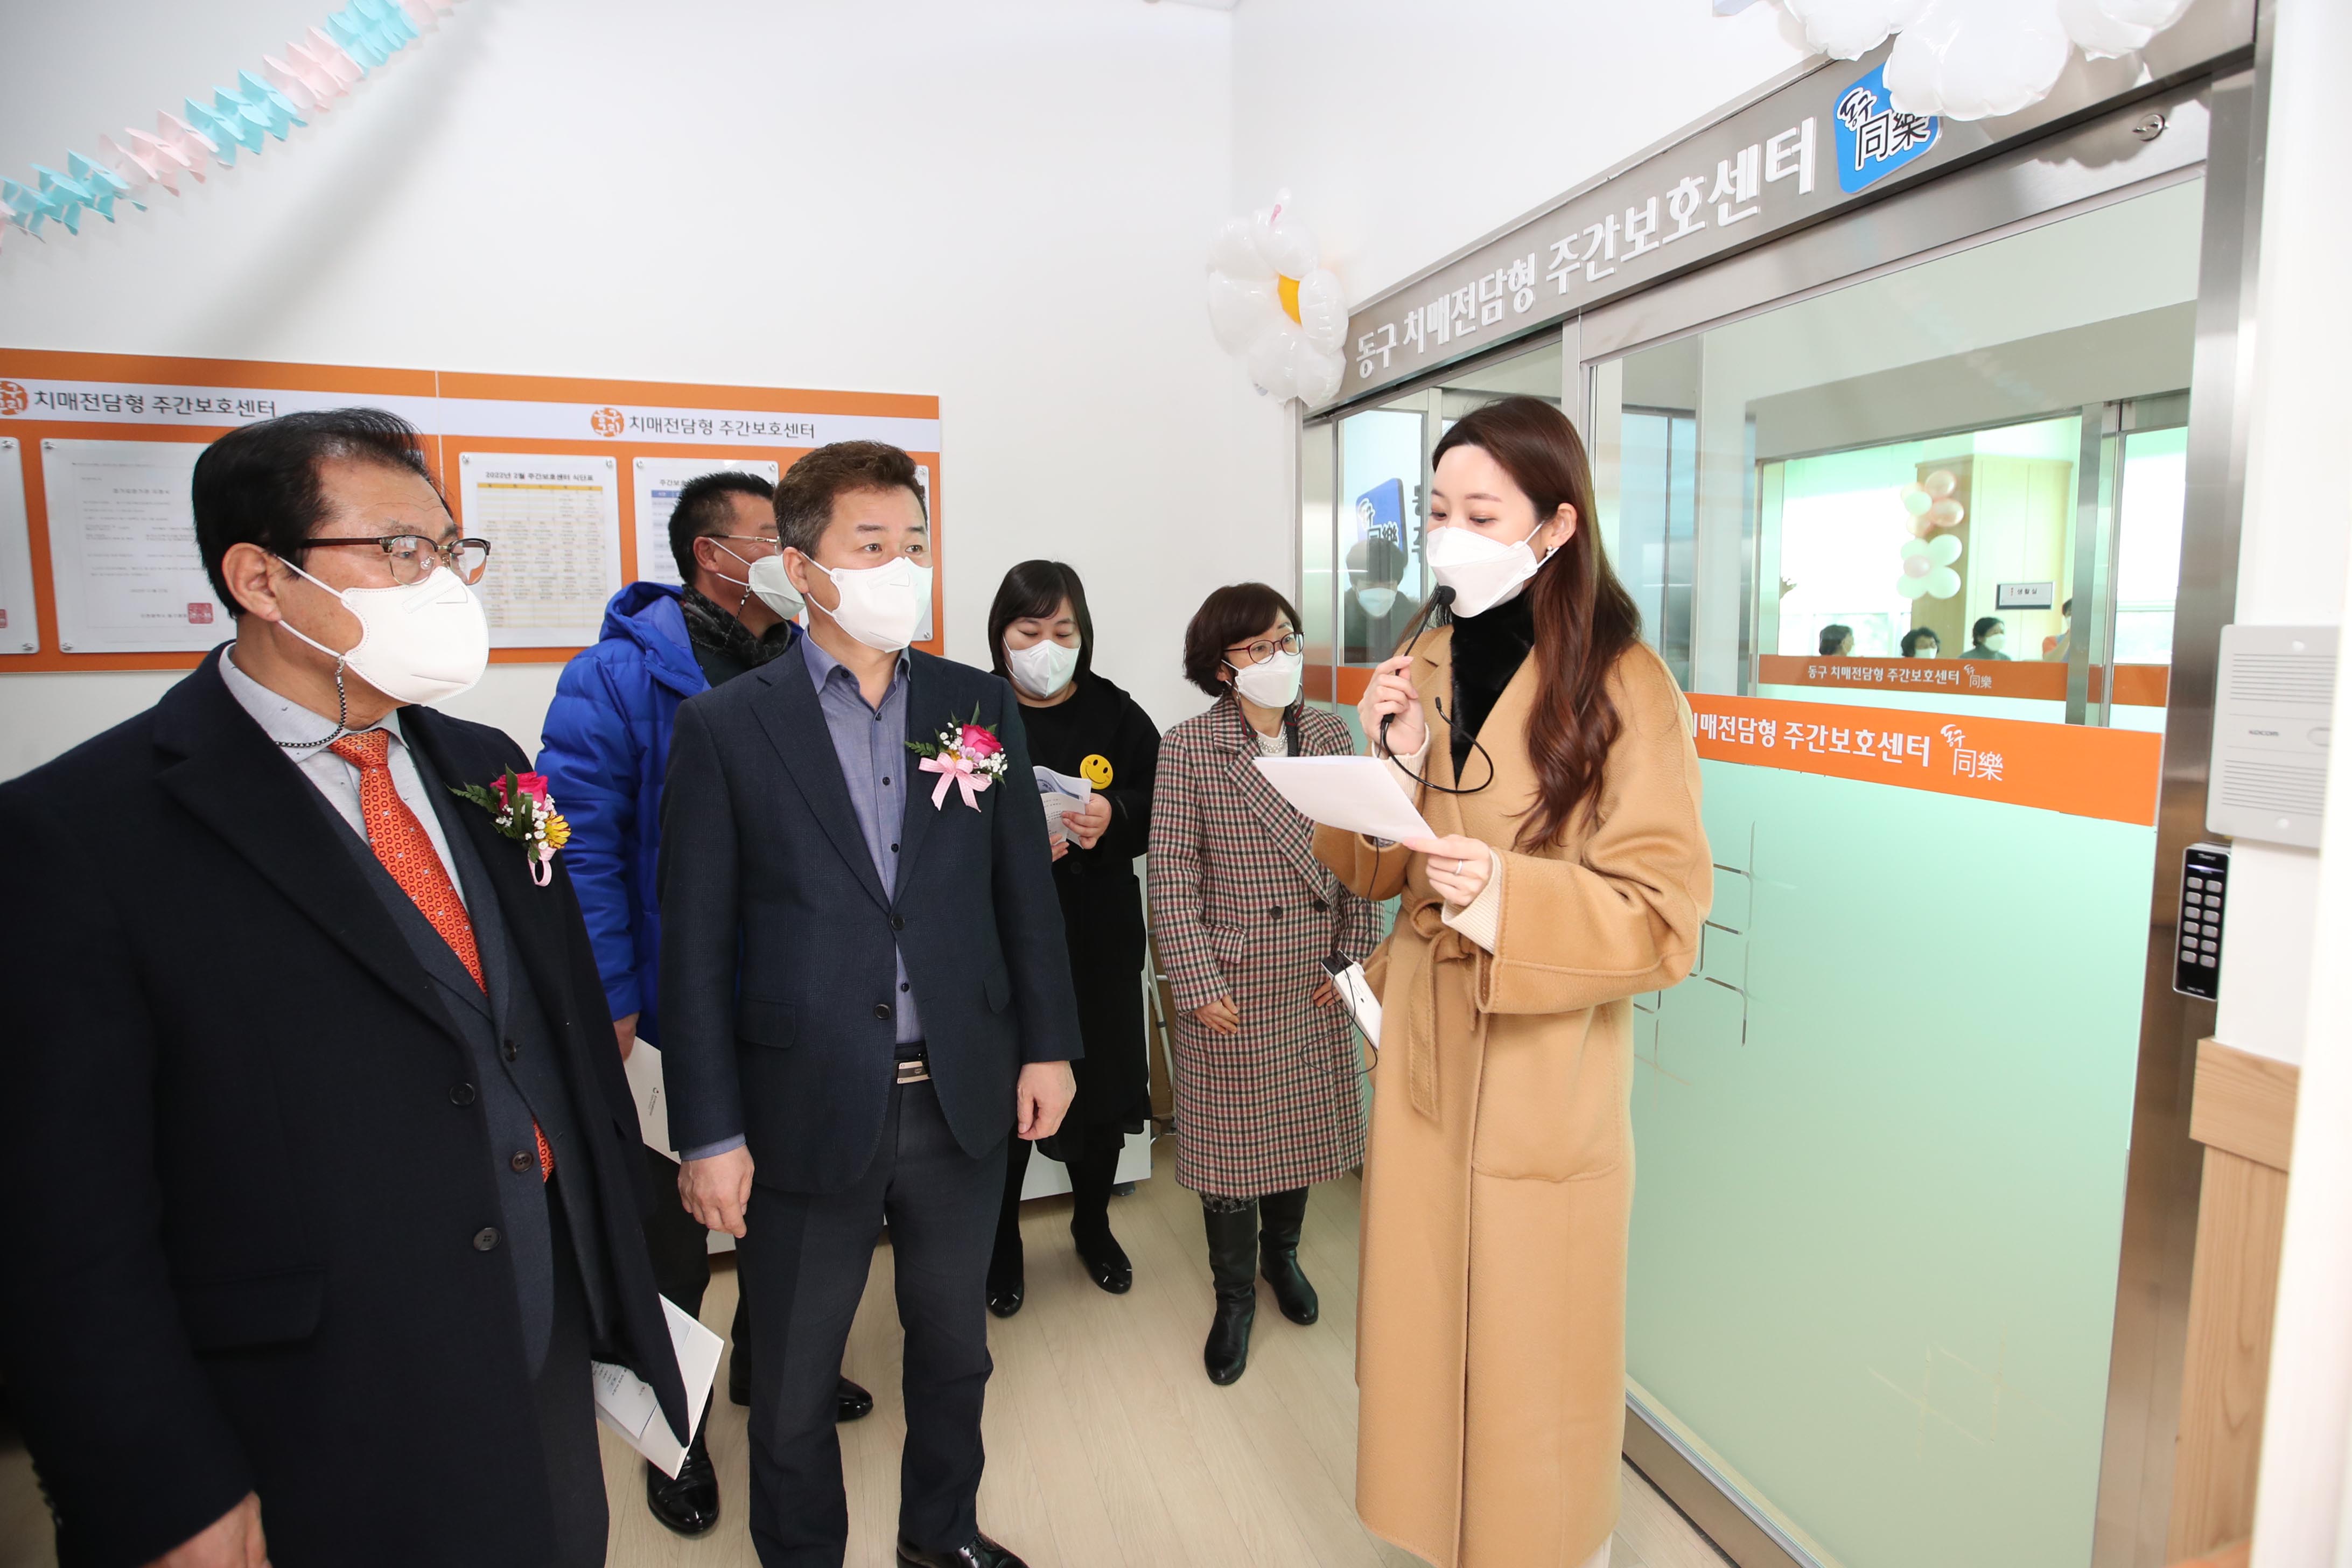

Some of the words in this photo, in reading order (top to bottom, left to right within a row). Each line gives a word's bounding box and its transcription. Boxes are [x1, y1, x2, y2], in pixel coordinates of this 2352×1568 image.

[1356, 323, 1397, 379] 동구
[1402, 252, 1536, 354] 치매전담형
[1545, 116, 1817, 295] 주간보호센터
[33, 390, 144, 414] 치매전담형
[152, 396, 276, 418] 주간보호센터
[628, 415, 713, 436] 치매전담형
[719, 419, 815, 439] 주간보호센터
[527, 473, 570, 481] 주간보호센터
[1808, 665, 1828, 679] 동구
[1831, 666, 1884, 682] 치매전담형
[1887, 667, 1960, 685] 주간보호센터
[1783, 722, 1930, 767] 주간보호센터
[1952, 748, 2004, 781] 同樂
